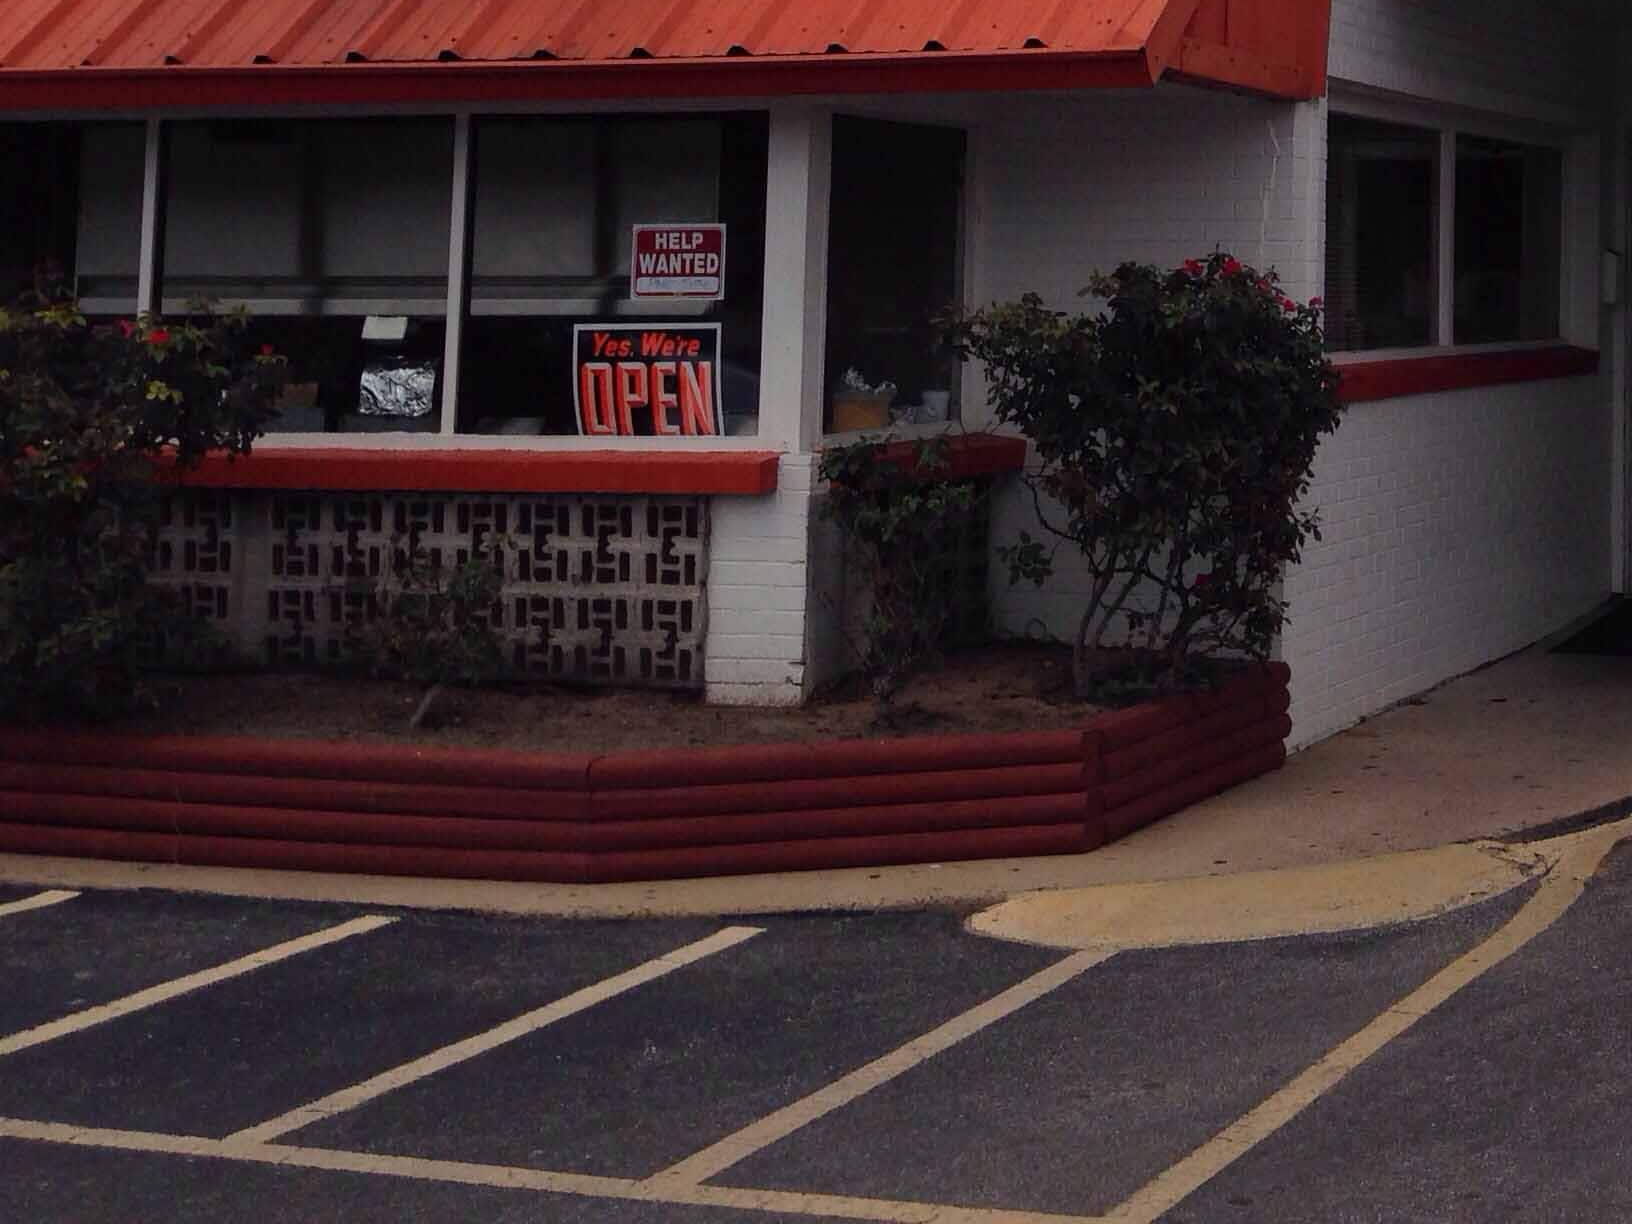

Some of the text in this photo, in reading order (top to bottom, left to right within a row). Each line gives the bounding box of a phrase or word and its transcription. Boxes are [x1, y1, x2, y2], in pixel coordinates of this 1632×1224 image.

[655, 231, 704, 250] HELP
[639, 252, 720, 275] WANTED
[580, 361, 717, 436] OPEN
